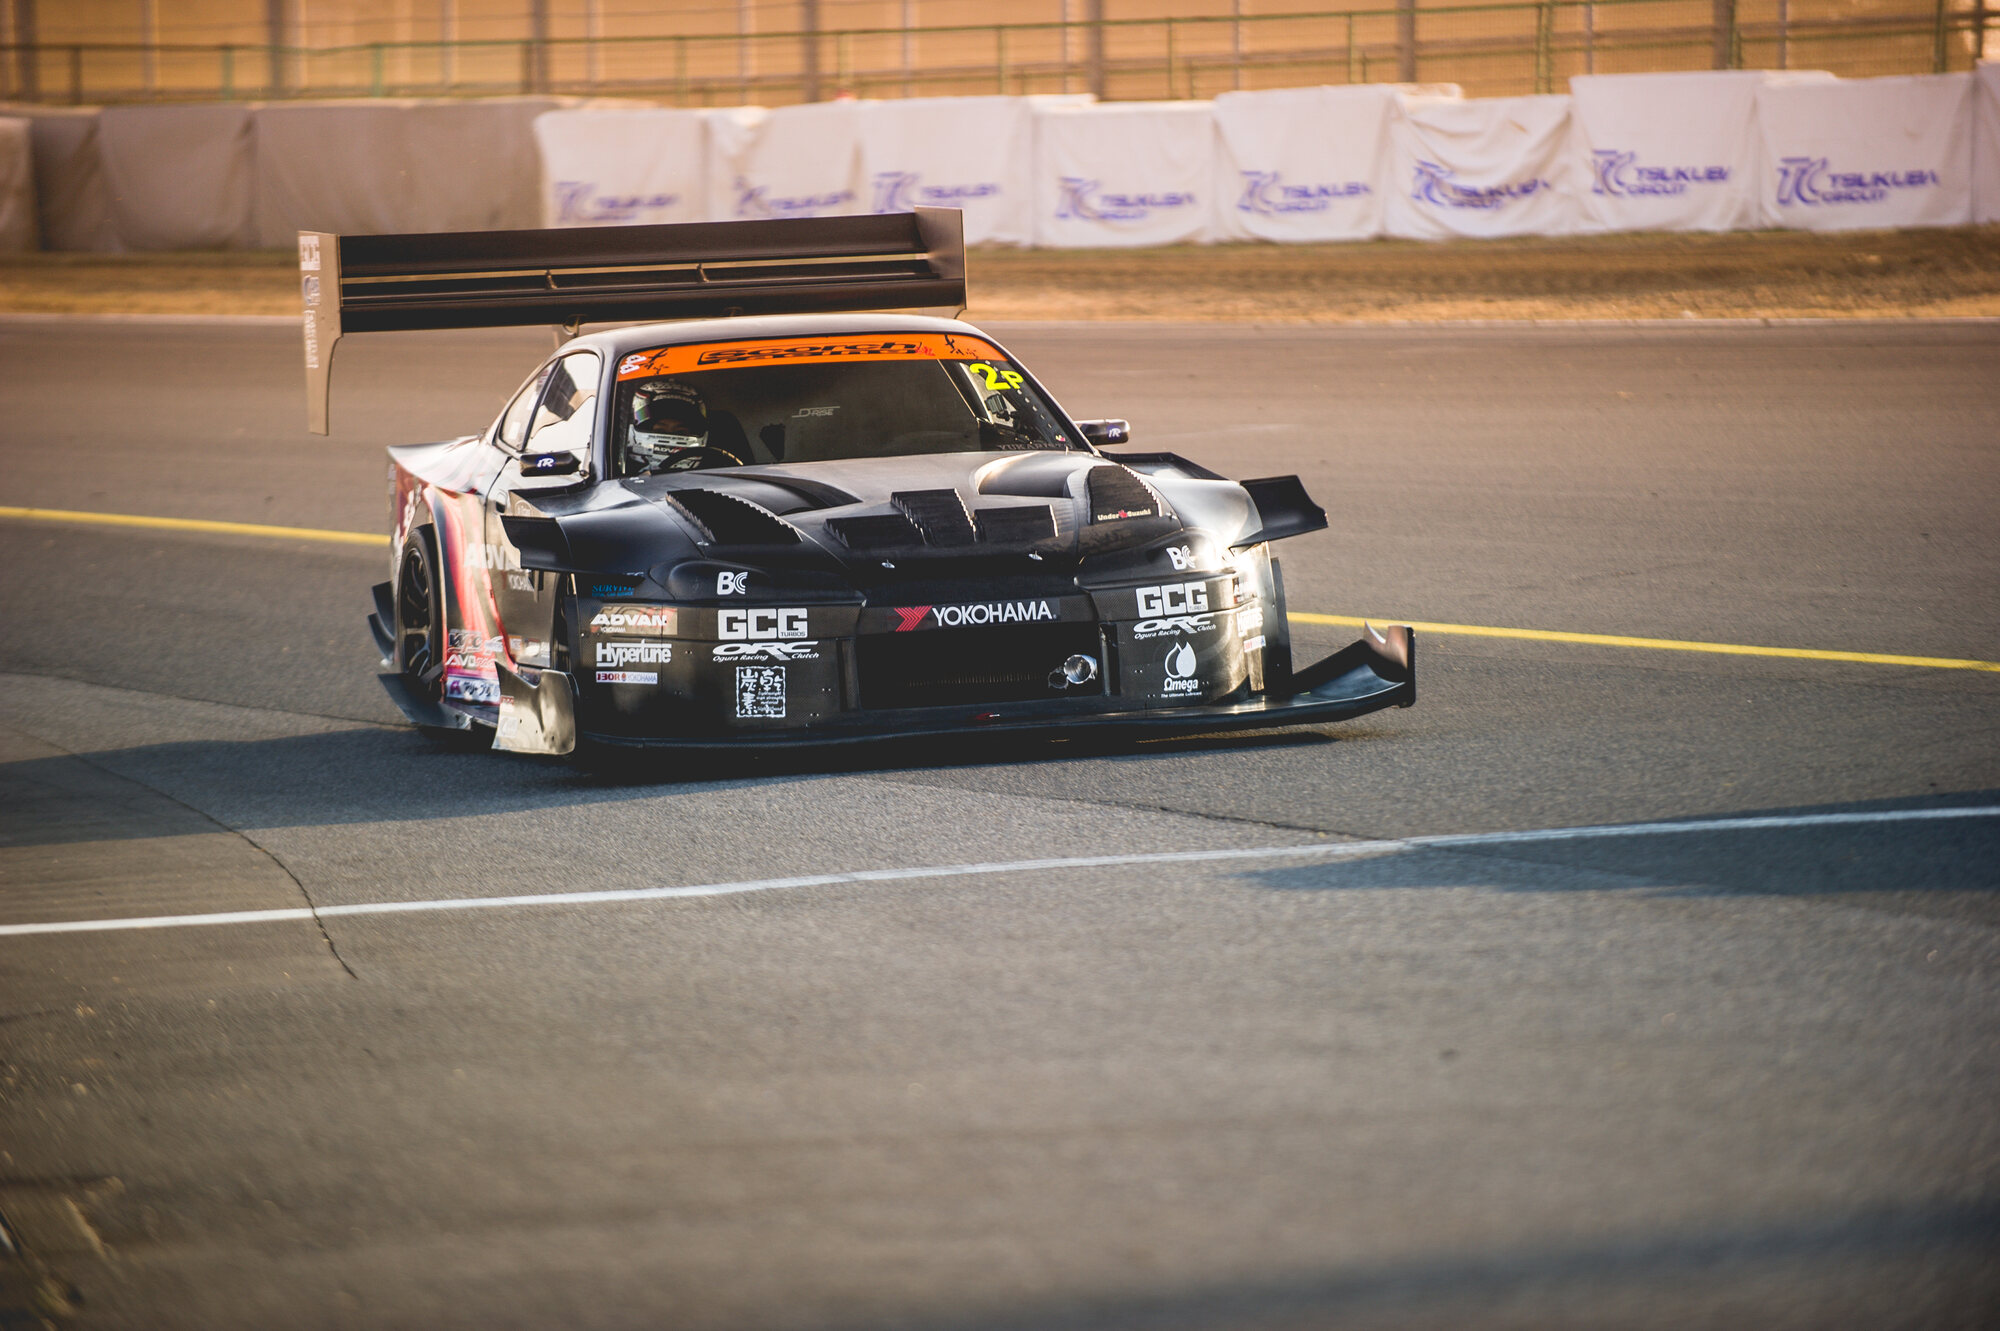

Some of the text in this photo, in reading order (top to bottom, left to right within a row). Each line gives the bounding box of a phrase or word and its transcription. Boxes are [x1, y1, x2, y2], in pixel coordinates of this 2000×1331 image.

[969, 363, 1024, 390] 2P
[717, 571, 748, 595] BC
[1136, 581, 1208, 618] GCG
[590, 614, 668, 626] ADVAN
[718, 608, 808, 640] GCG
[932, 600, 1053, 627] YOKOHAMA
[1133, 613, 1215, 634] ORC
[1134, 623, 1216, 640] Ogura Racing Clutch
[596, 639, 672, 667] Hypertune
[713, 640, 819, 661] ORC
[713, 655, 739, 663] Ogura
[791, 652, 820, 660] Clutch
